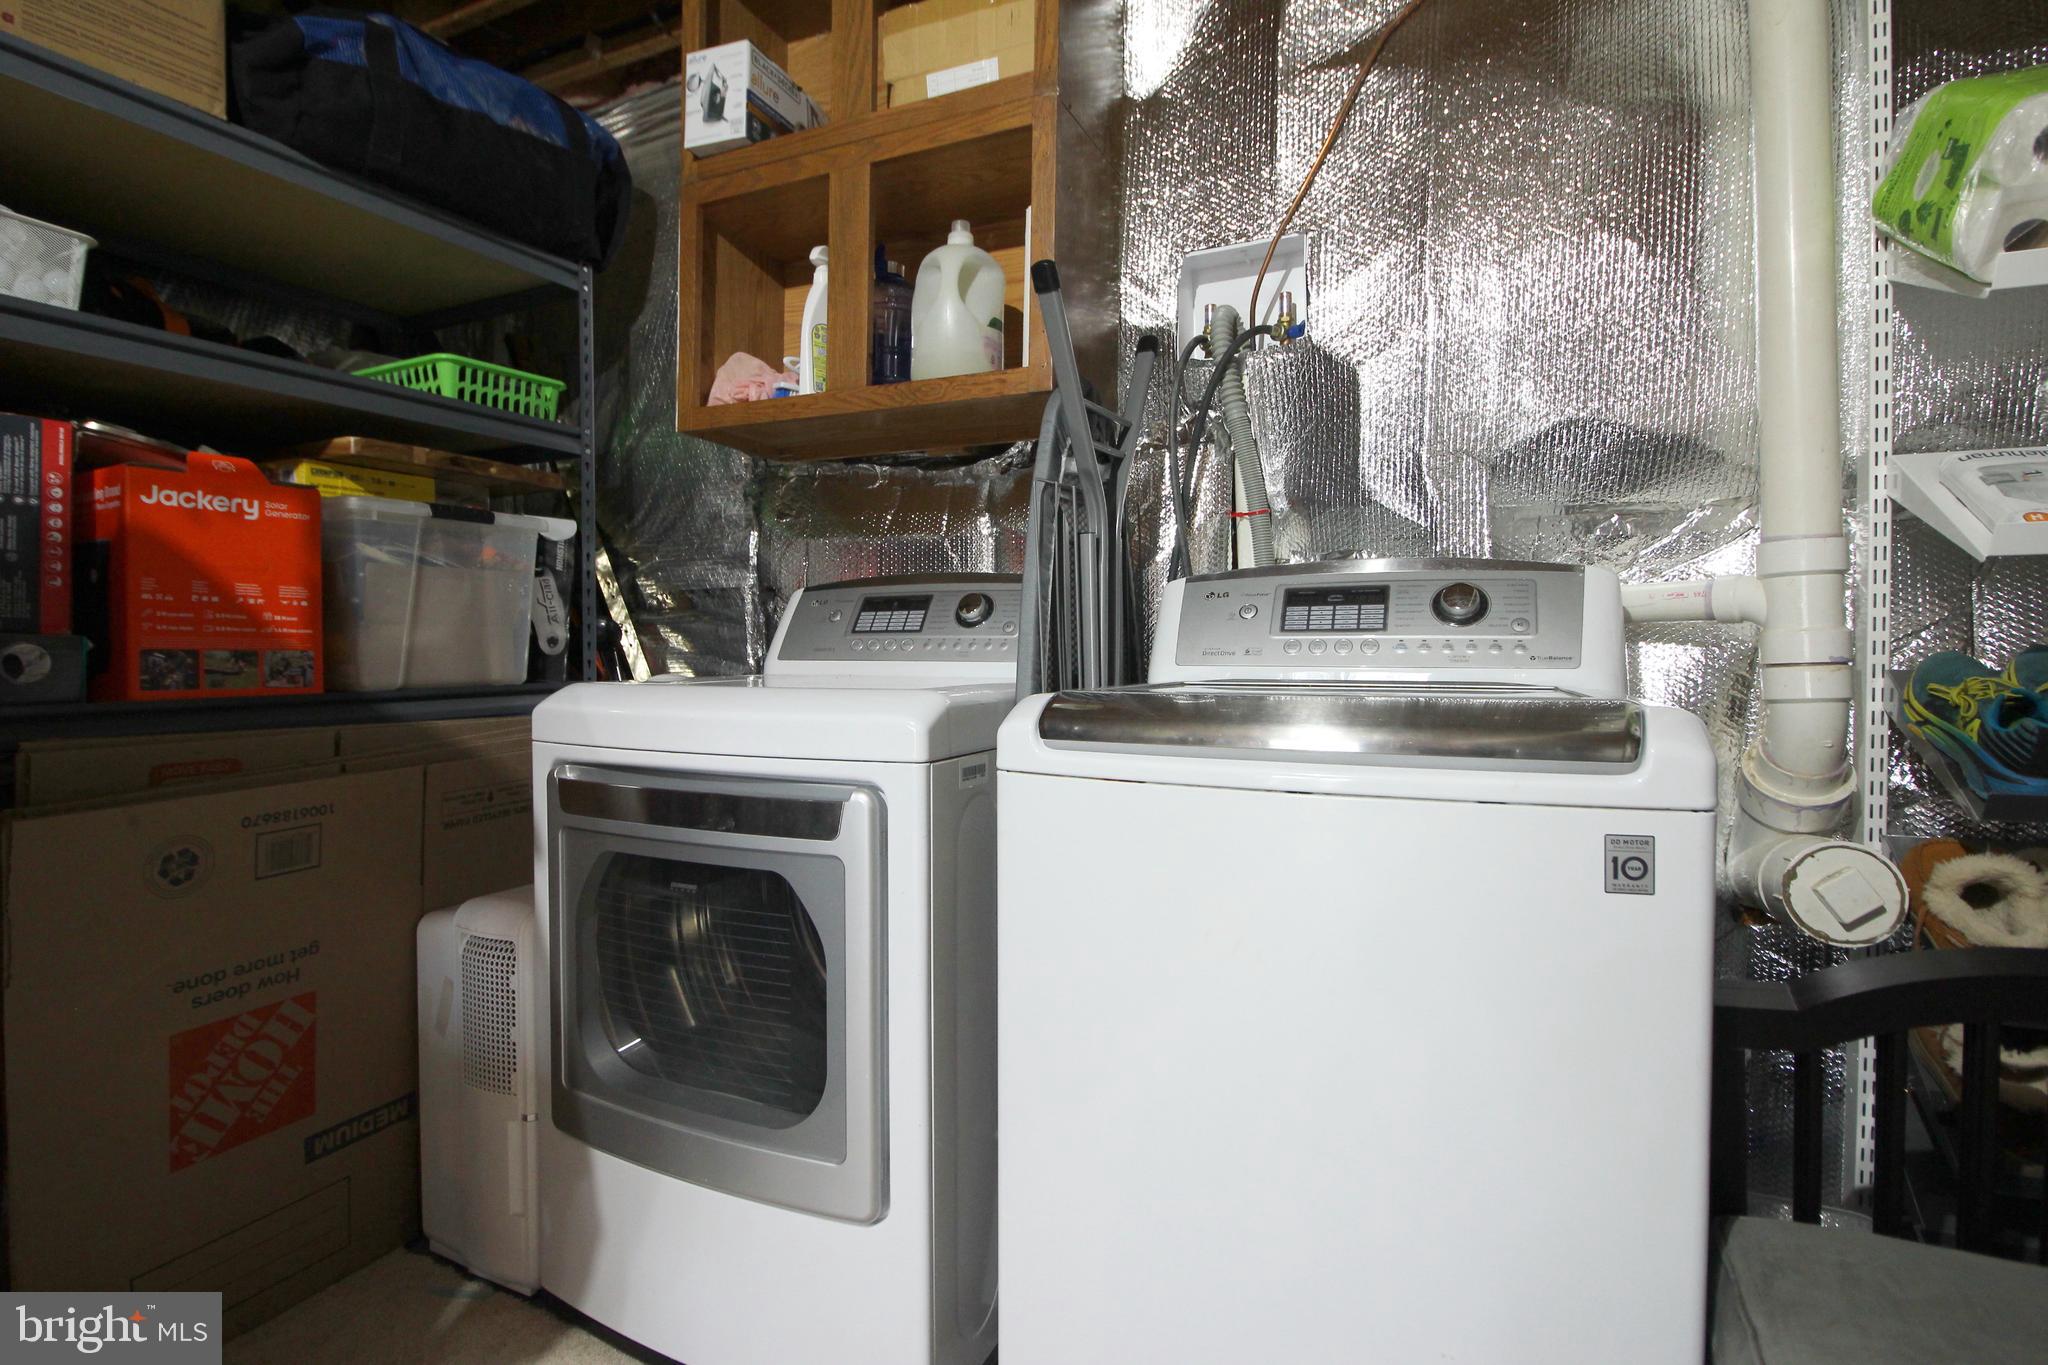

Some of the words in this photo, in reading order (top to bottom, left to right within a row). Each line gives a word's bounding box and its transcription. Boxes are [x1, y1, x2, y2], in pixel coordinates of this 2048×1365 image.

[750, 70, 779, 104] allure
[139, 484, 260, 521] Jackery
[264, 500, 288, 510] Solar
[264, 509, 310, 521] Generator
[542, 578, 560, 624] All-Clad
[241, 803, 336, 829] 1006188670
[1611, 856, 1648, 881] 10
[233, 953, 285, 978] more
[288, 940, 321, 965] get
[258, 967, 301, 991] How
[191, 982, 251, 1010] doers
[171, 1014, 263, 1119] DEPOT
[179, 999, 317, 1163] HOME
[244, 1064, 304, 1123] THE
[313, 1098, 409, 1156] MEDIUM
